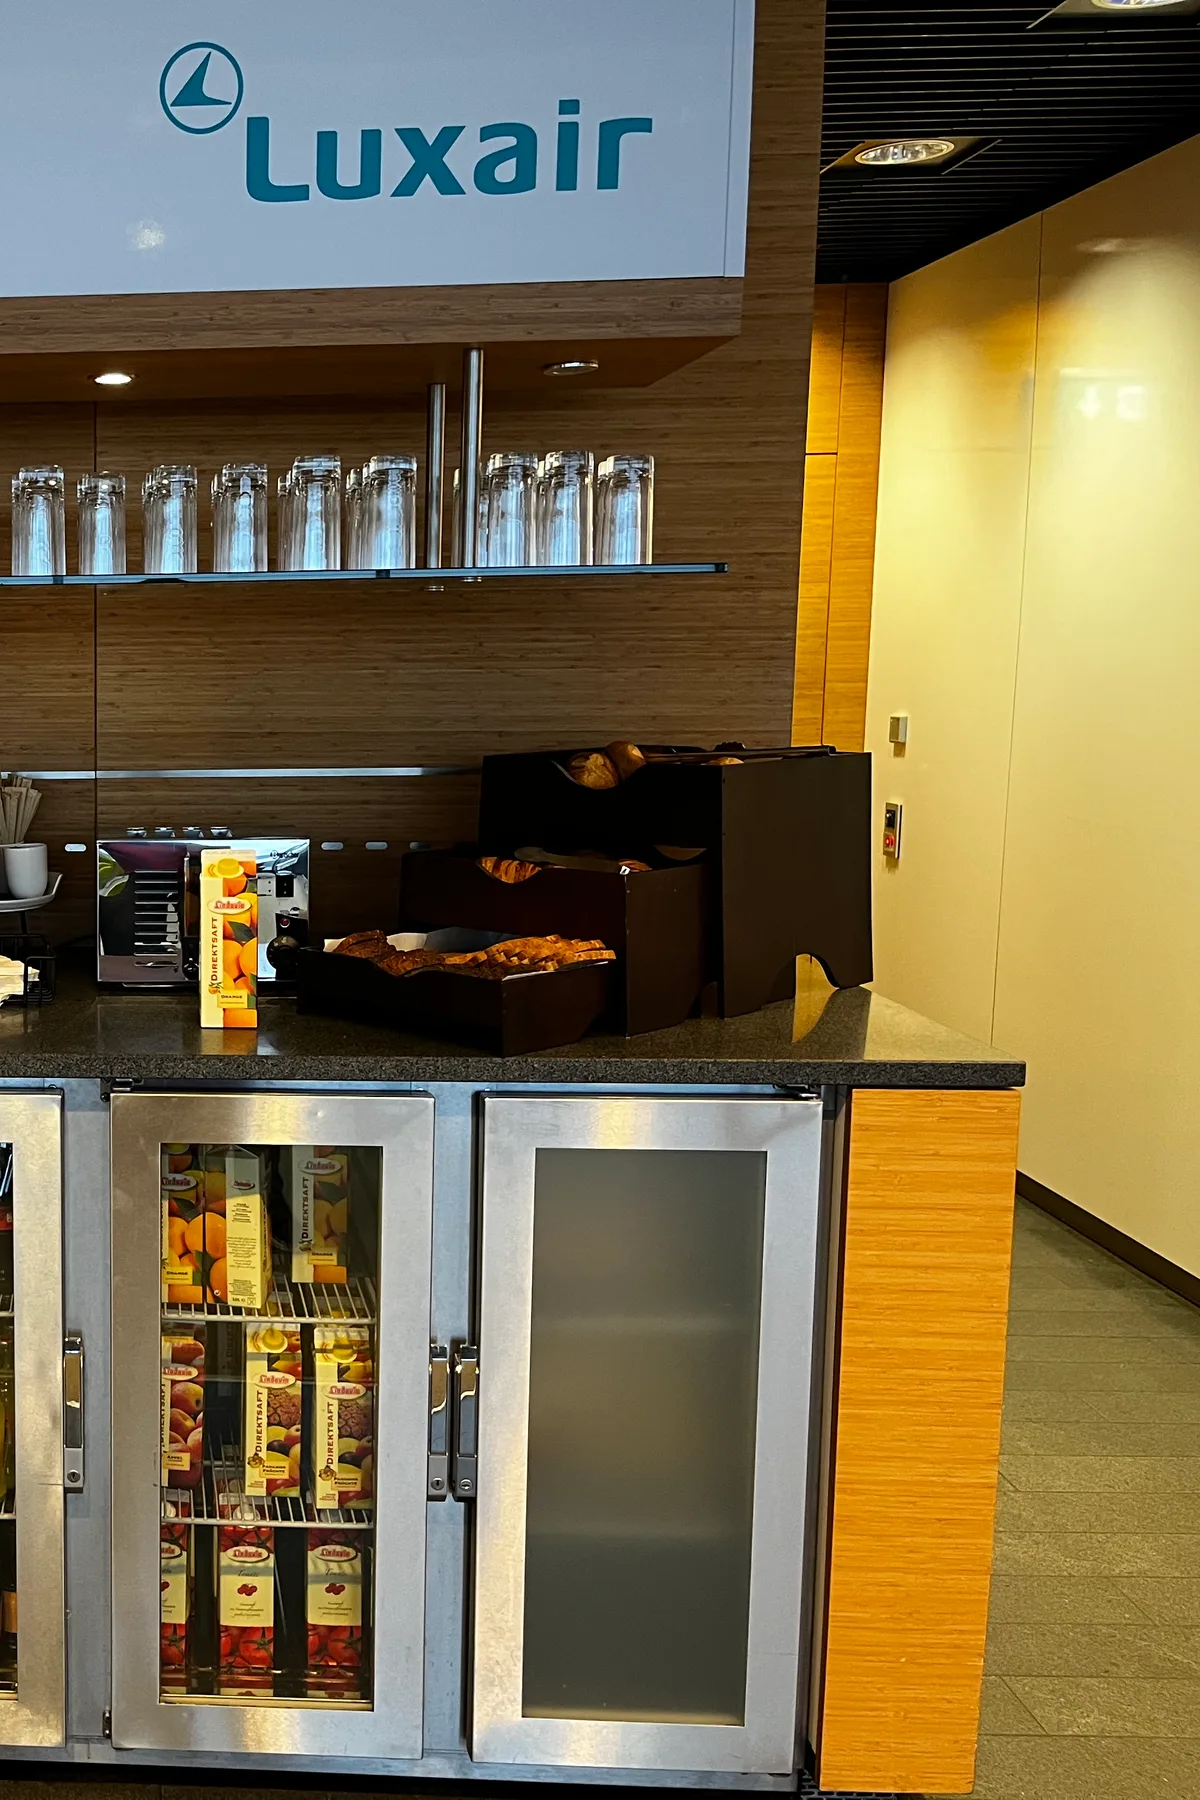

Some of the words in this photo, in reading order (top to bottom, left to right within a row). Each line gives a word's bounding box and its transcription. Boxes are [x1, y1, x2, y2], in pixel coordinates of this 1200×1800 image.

[246, 99, 653, 203] Luxair
[210, 917, 218, 982] DIREKTSAFT
[301, 1177, 309, 1239] DIREKTSAFT
[255, 1390, 263, 1452] DIREKTSAFT
[326, 1402, 334, 1465] DIREKTSAFT
